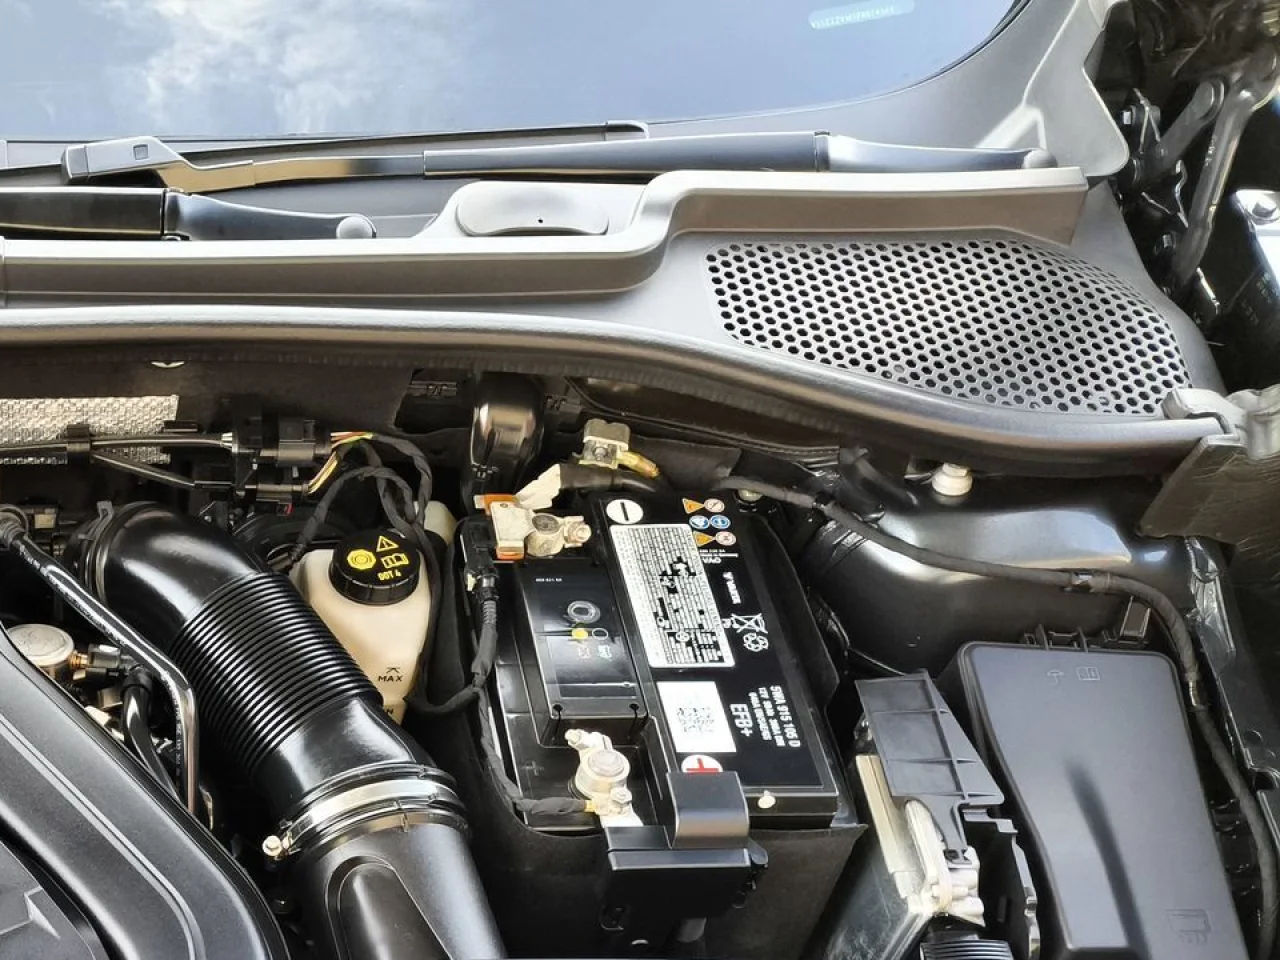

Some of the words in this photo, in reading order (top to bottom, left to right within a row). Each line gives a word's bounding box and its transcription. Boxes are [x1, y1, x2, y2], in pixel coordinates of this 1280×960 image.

[377, 570, 394, 580] DOT
[395, 569, 402, 577] 4
[730, 703, 753, 737] EFB+
[777, 705, 793, 721] 915
